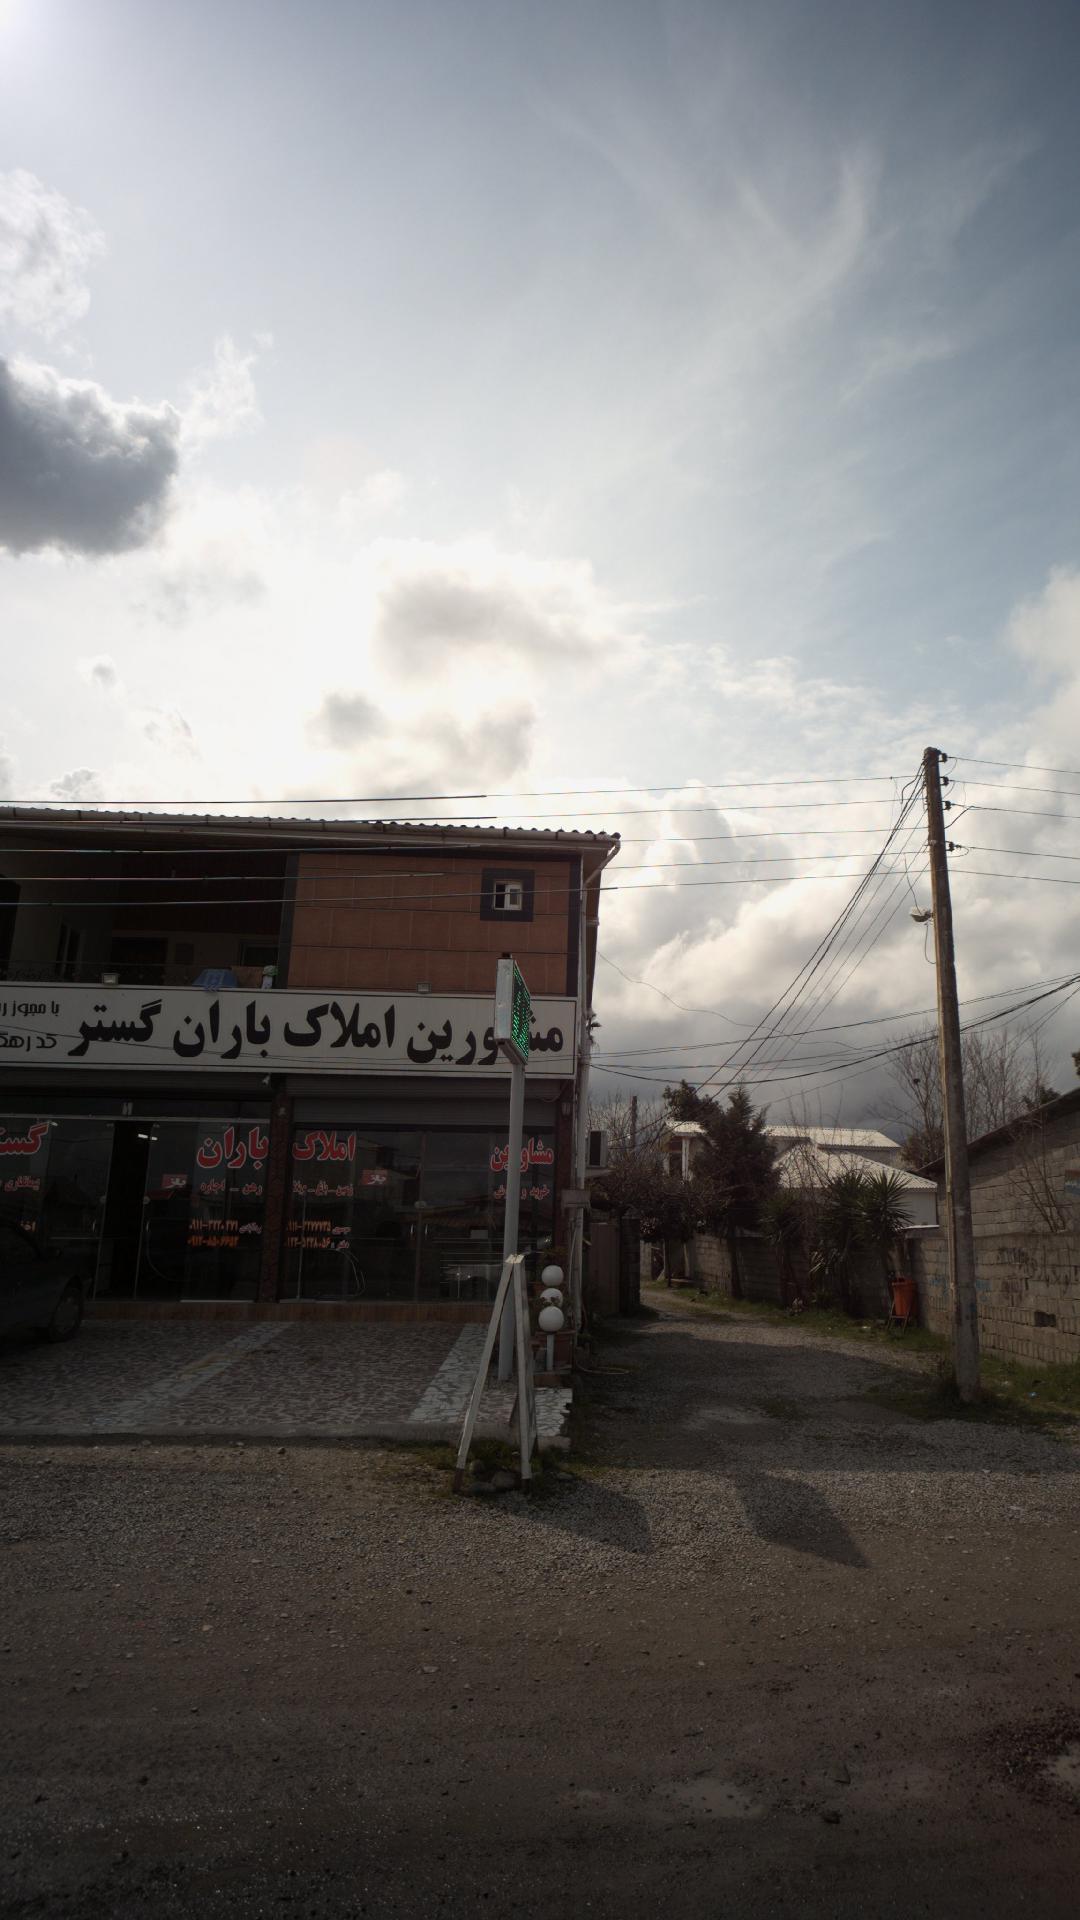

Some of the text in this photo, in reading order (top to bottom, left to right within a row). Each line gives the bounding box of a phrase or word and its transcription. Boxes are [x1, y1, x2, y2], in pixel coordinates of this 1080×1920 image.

[12, 1000, 46, 1017] مجوز
[51, 1000, 60, 1017] با
[67, 999, 162, 1056] گستر
[284, 1001, 395, 1048] املاک
[36, 1032, 57, 1049] کد
[173, 999, 271, 1059] باران
[407, 1007, 563, 1065] مشورین
[196, 1126, 269, 1170] باران
[292, 1129, 357, 1161] املاک
[490, 1136, 555, 1173] مشاوین
